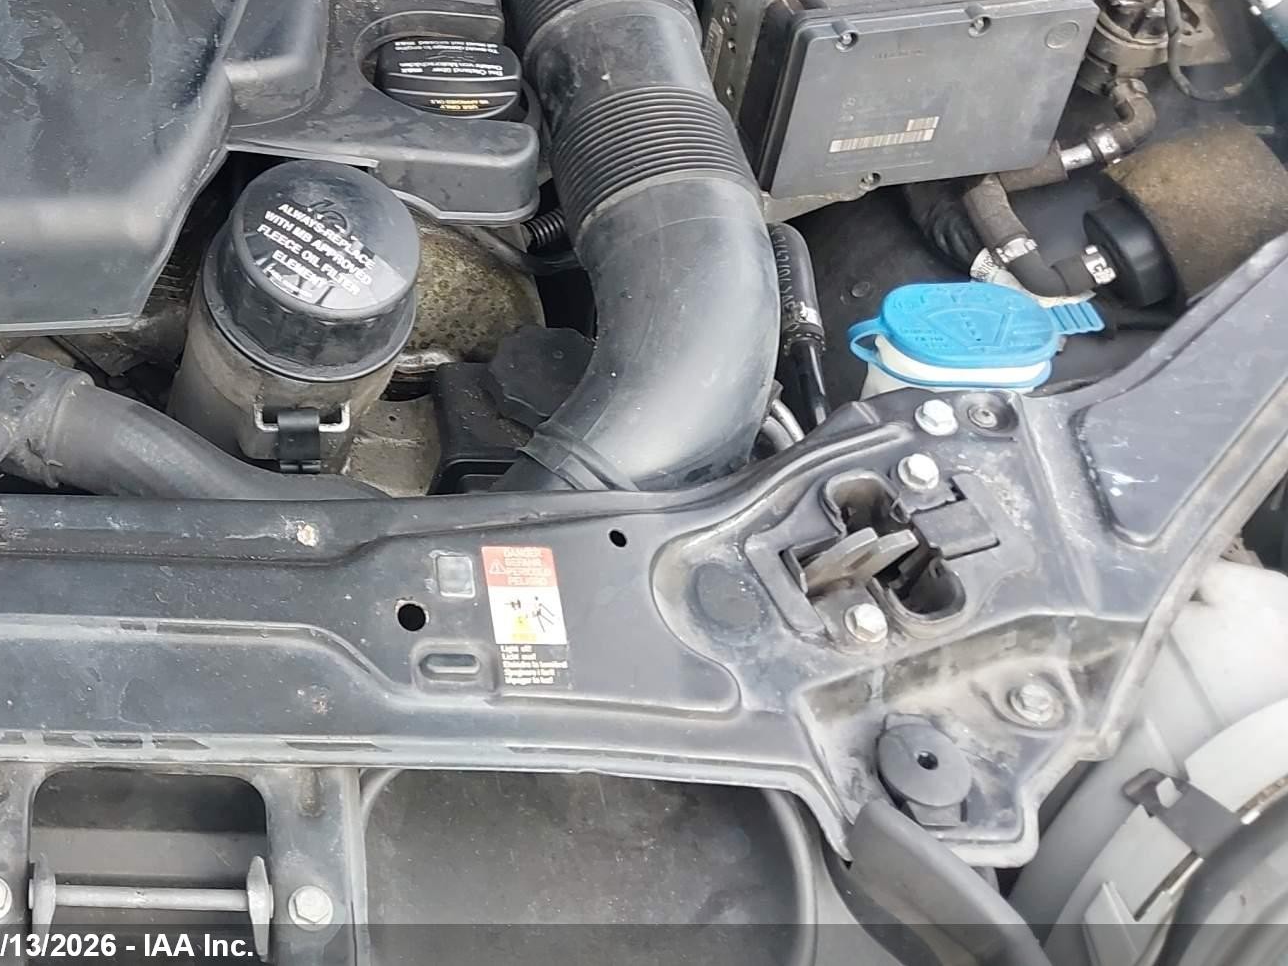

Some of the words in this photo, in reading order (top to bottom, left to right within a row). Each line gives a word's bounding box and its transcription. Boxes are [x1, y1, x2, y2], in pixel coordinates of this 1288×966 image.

[256, 223, 303, 254] FLEECE
[301, 250, 321, 268] OIL
[264, 210, 294, 232] WITH
[291, 227, 313, 243] MB
[310, 239, 372, 285] APPROVED
[278, 203, 326, 233] ALWAYS
[323, 228, 376, 270] REPLACE
